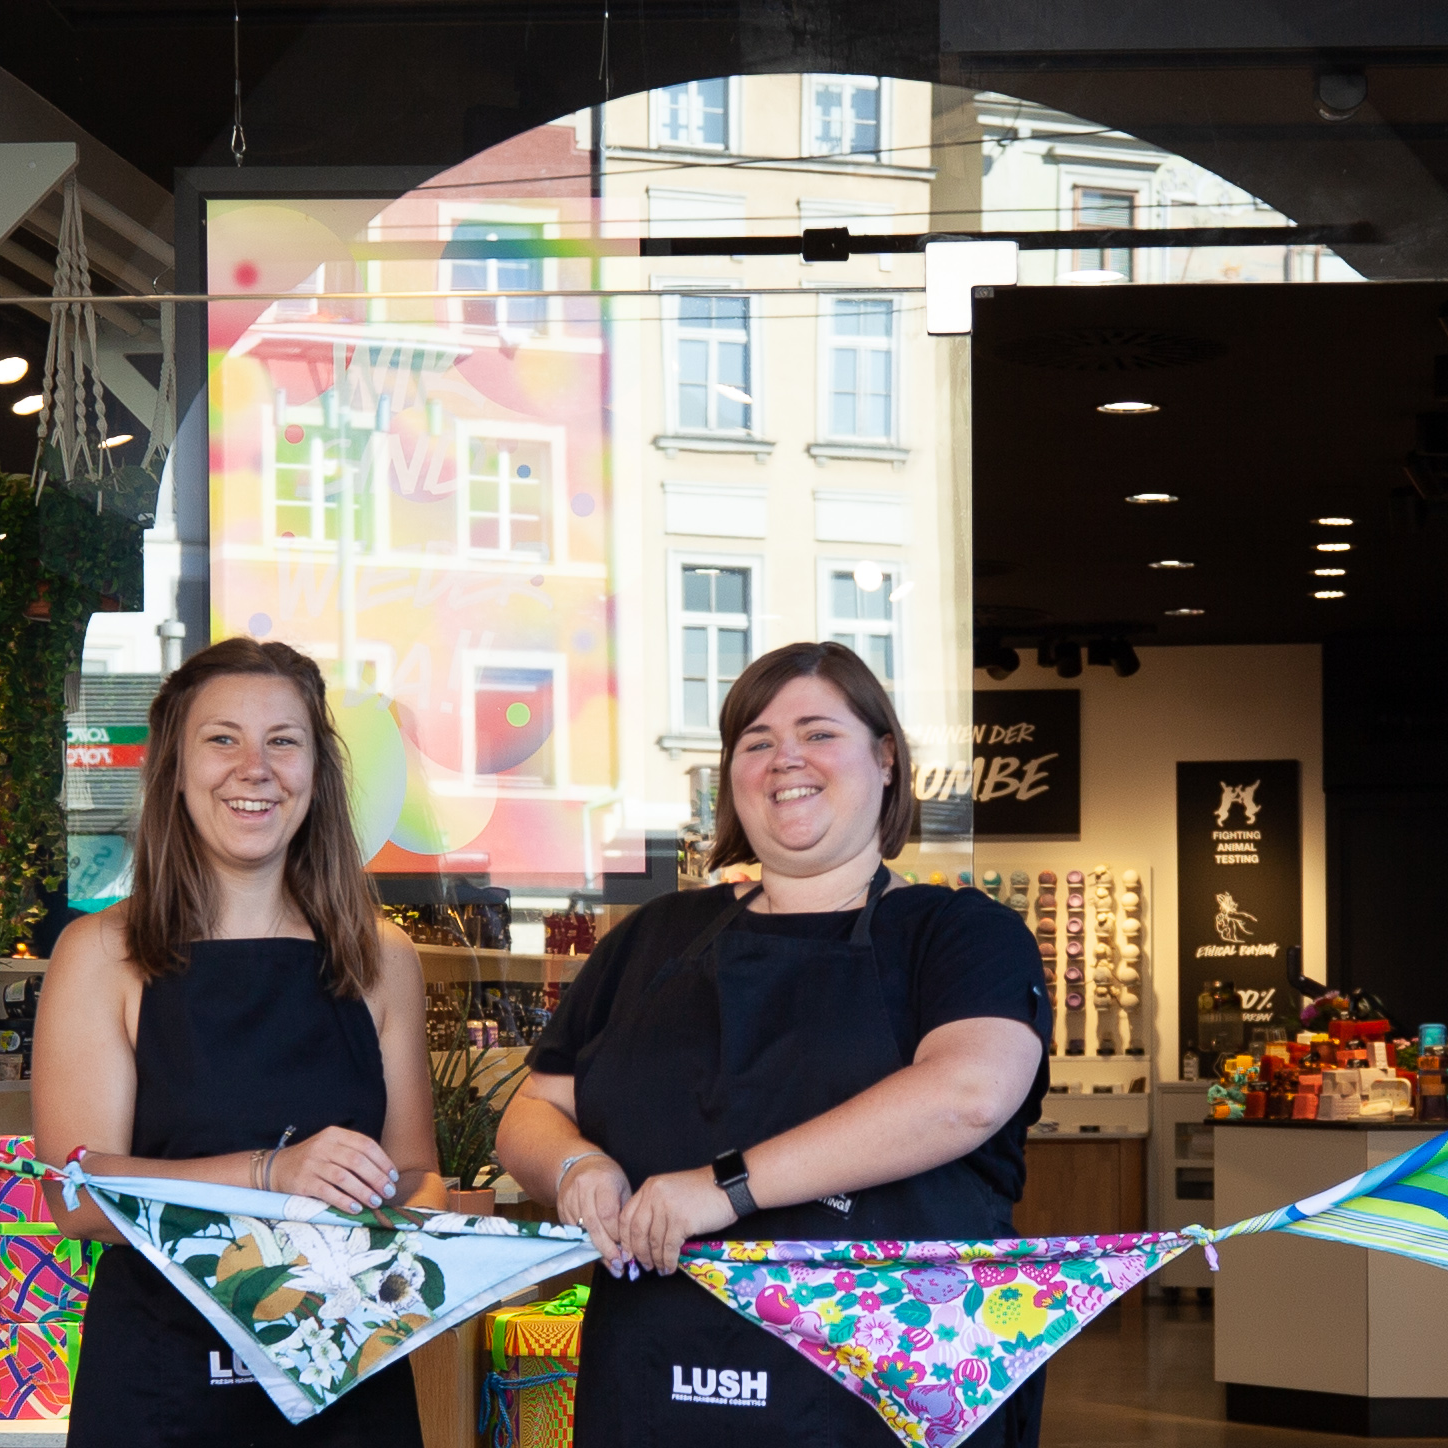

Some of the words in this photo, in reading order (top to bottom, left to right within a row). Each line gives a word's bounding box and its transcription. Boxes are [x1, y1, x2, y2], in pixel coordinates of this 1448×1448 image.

[988, 722, 1035, 745] DER
[910, 753, 1059, 802] OMBE
[1212, 831, 1262, 840] FIGHTING
[1216, 842, 1257, 852] ANIMAL
[1214, 854, 1260, 864] TESTING
[1196, 945, 1237, 958] ETHICAL
[1239, 943, 1279, 958] BUYING
[209, 1351, 254, 1377] LU
[672, 1365, 768, 1400] LUSH
